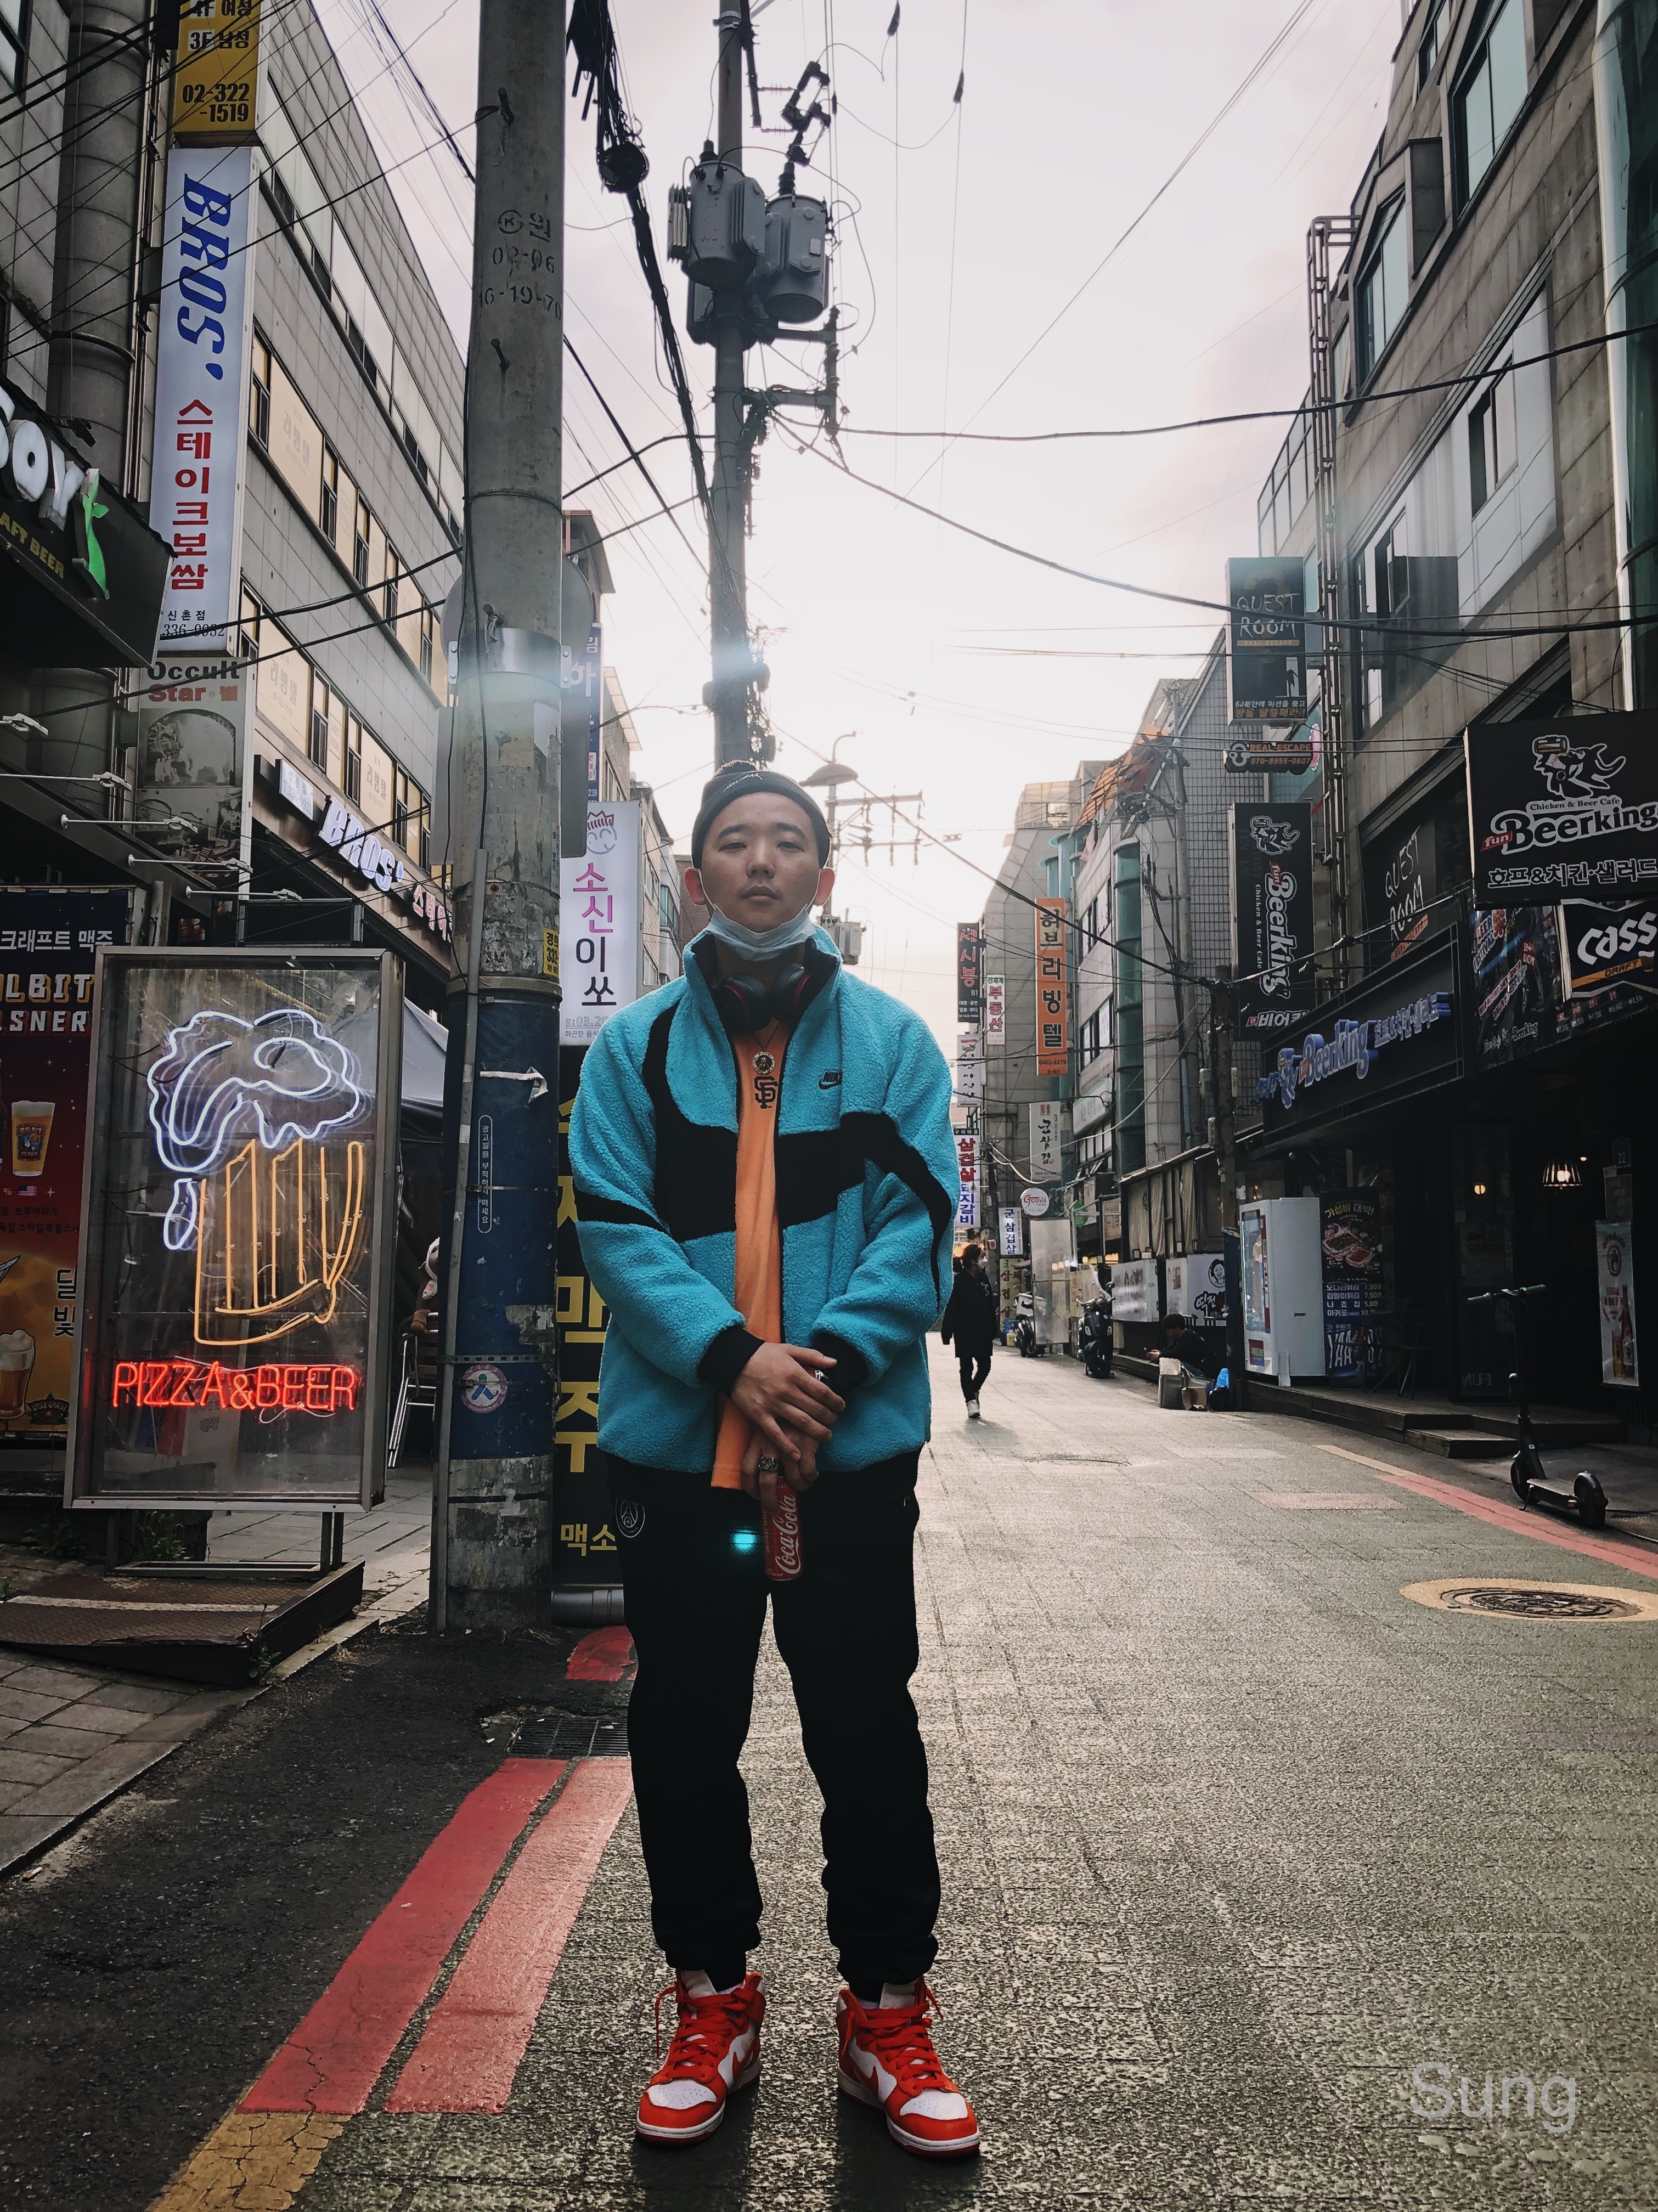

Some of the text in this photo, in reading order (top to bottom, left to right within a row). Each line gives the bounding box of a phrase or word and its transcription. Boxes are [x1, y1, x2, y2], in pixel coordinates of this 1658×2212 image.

[182, 83, 250, 103] 02-322
[200, 103, 249, 122] -1519
[170, 399, 213, 590] 스테이크보쌈
[30, 537, 65, 579] BEER
[167, 610, 205, 620] 신촌점
[1237, 594, 1300, 638] QUEST ROOM
[146, 661, 240, 681] Occult
[148, 684, 206, 702] Star
[1530, 802, 1565, 811] Chicken
[1577, 799, 1598, 808] Beer
[1600, 797, 1620, 805] Cafe
[1484, 803, 1658, 855] fun Beerking
[1385, 825, 1424, 947] QUEST ROOM
[0, 930, 71, 952] 크래프트
[573, 862, 617, 1006] 소신이쏘
[1261, 872, 1296, 998] Beerking
[1605, 960, 1638, 977] DRAFT
[989, 986, 1003, 1032] 부동산
[1042, 957, 1062, 1048] 리빙텔
